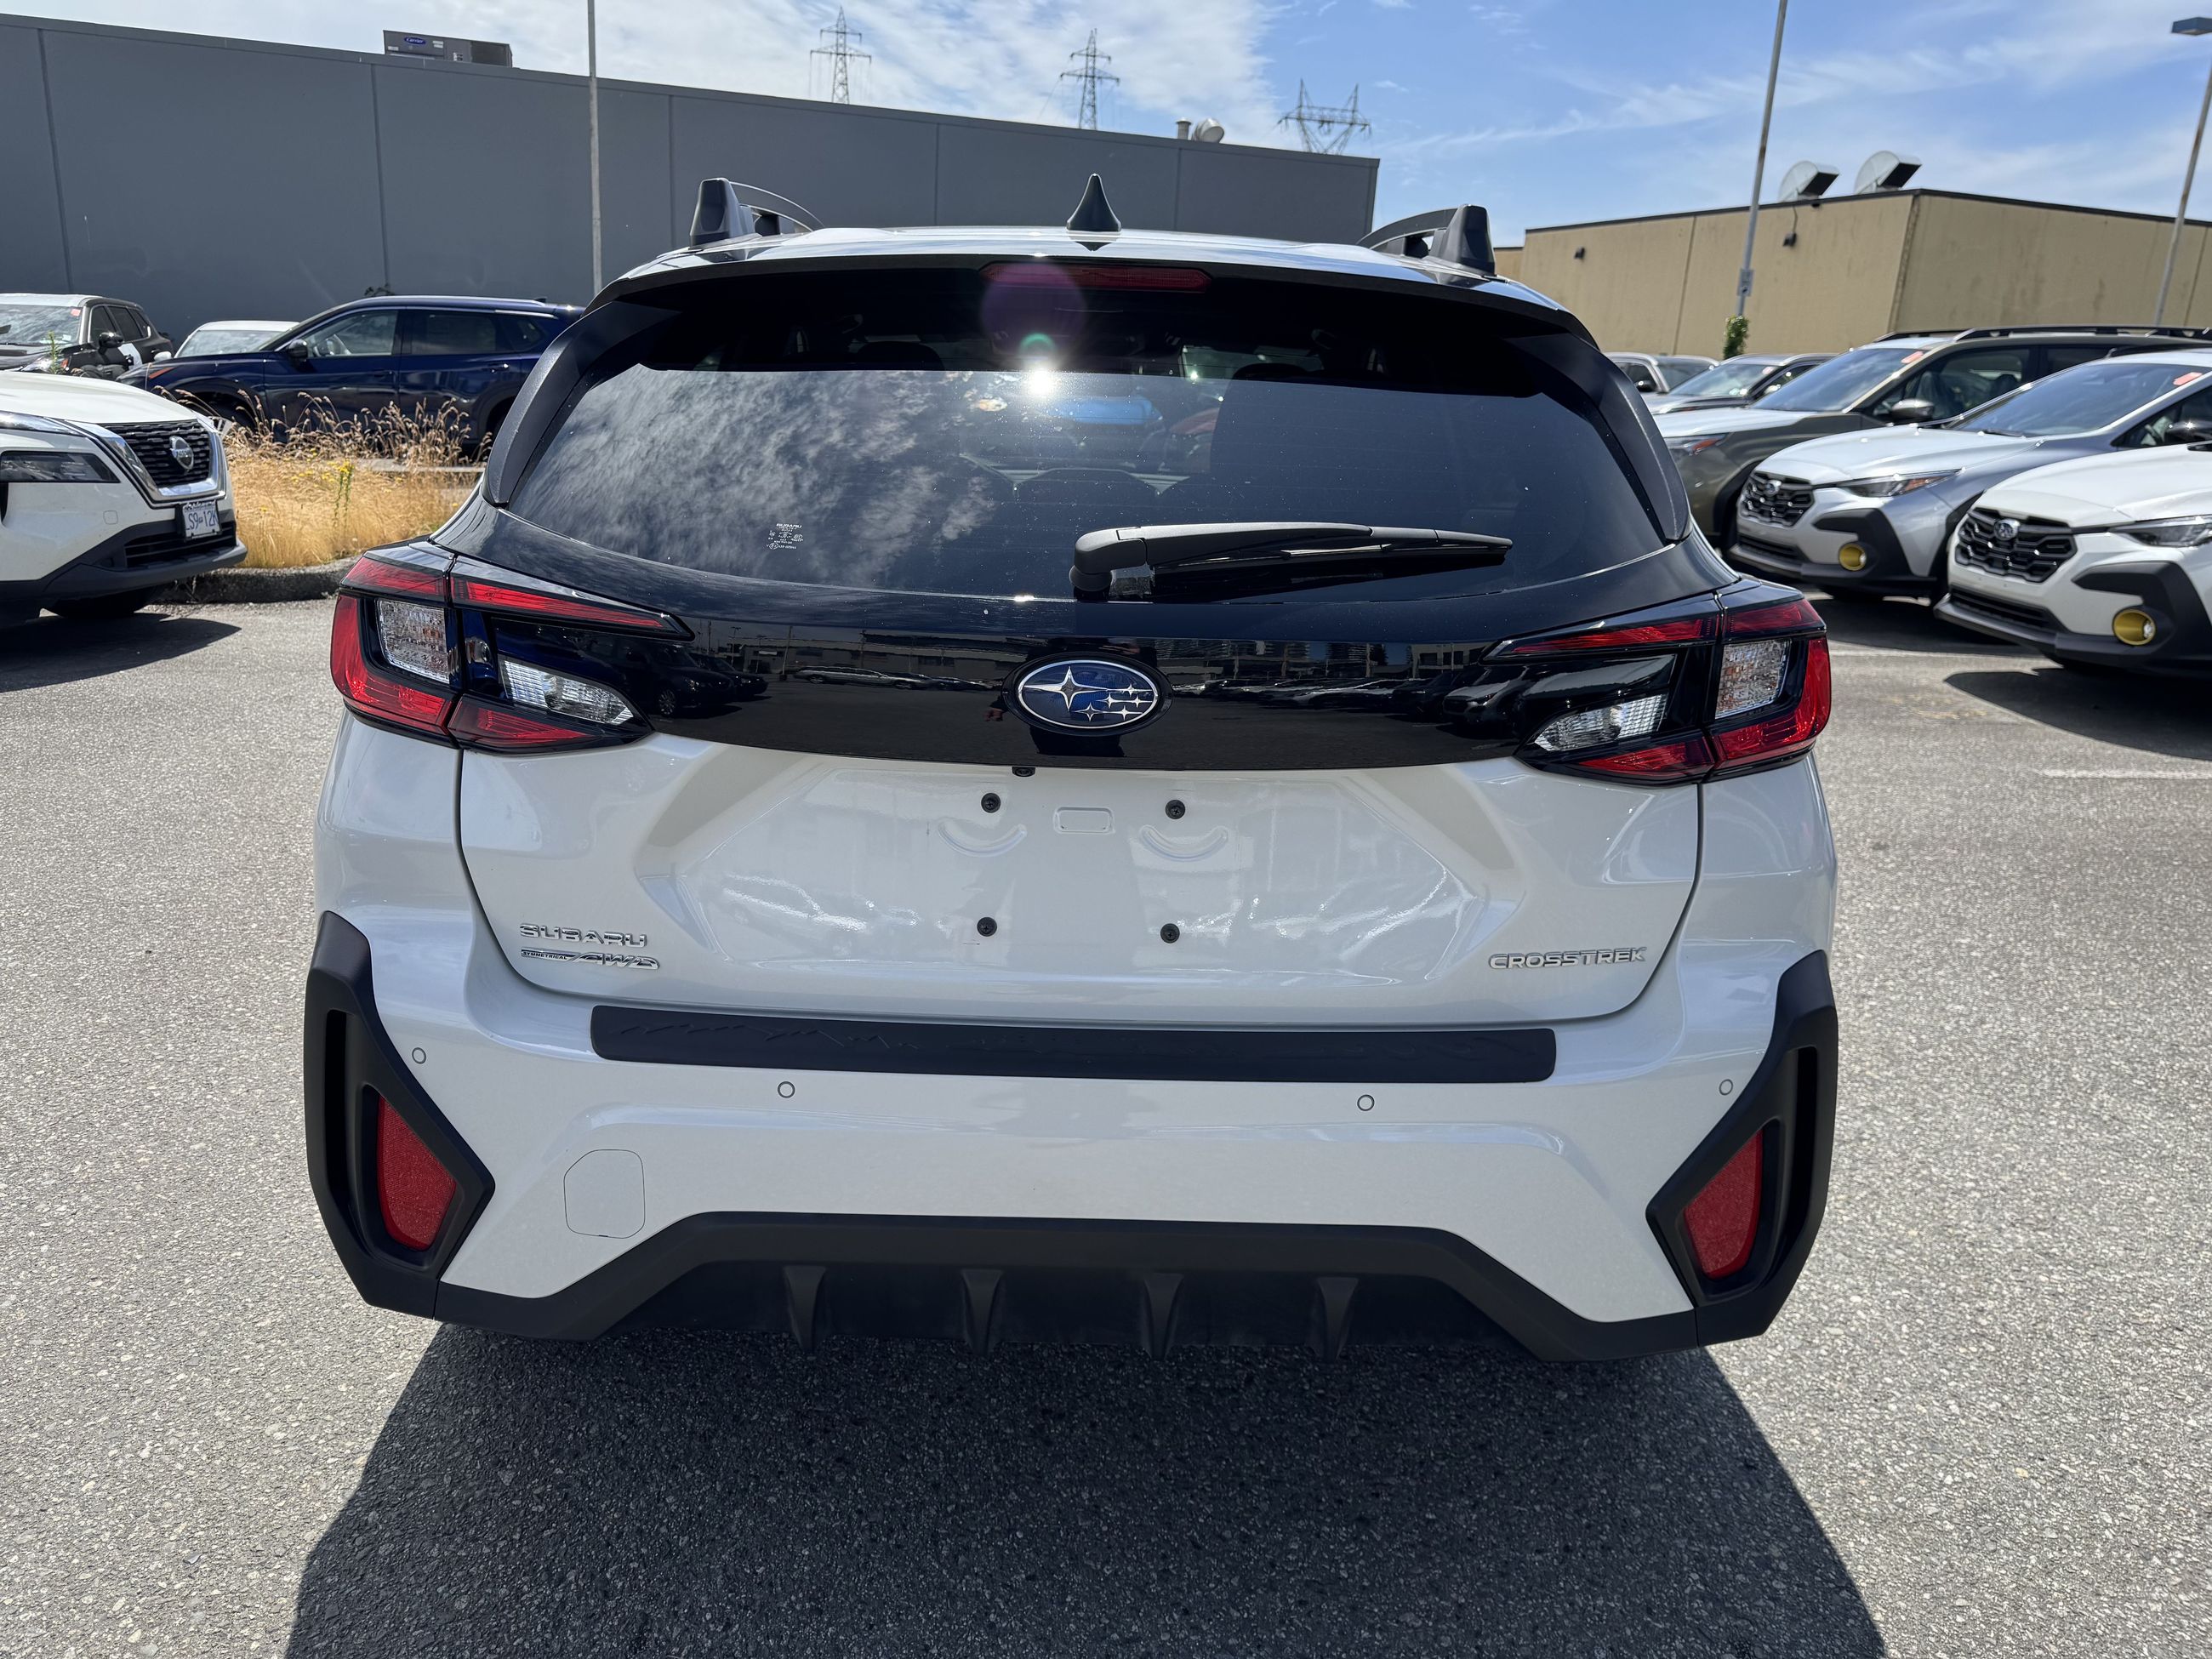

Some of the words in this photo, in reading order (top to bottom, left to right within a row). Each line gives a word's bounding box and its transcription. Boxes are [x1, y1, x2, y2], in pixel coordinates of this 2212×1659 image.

[519, 922, 647, 948] SUBARU
[522, 950, 568, 961] SYMMETRICAL
[573, 951, 660, 970] AWD
[1489, 946, 1647, 969] CROSSTREK
